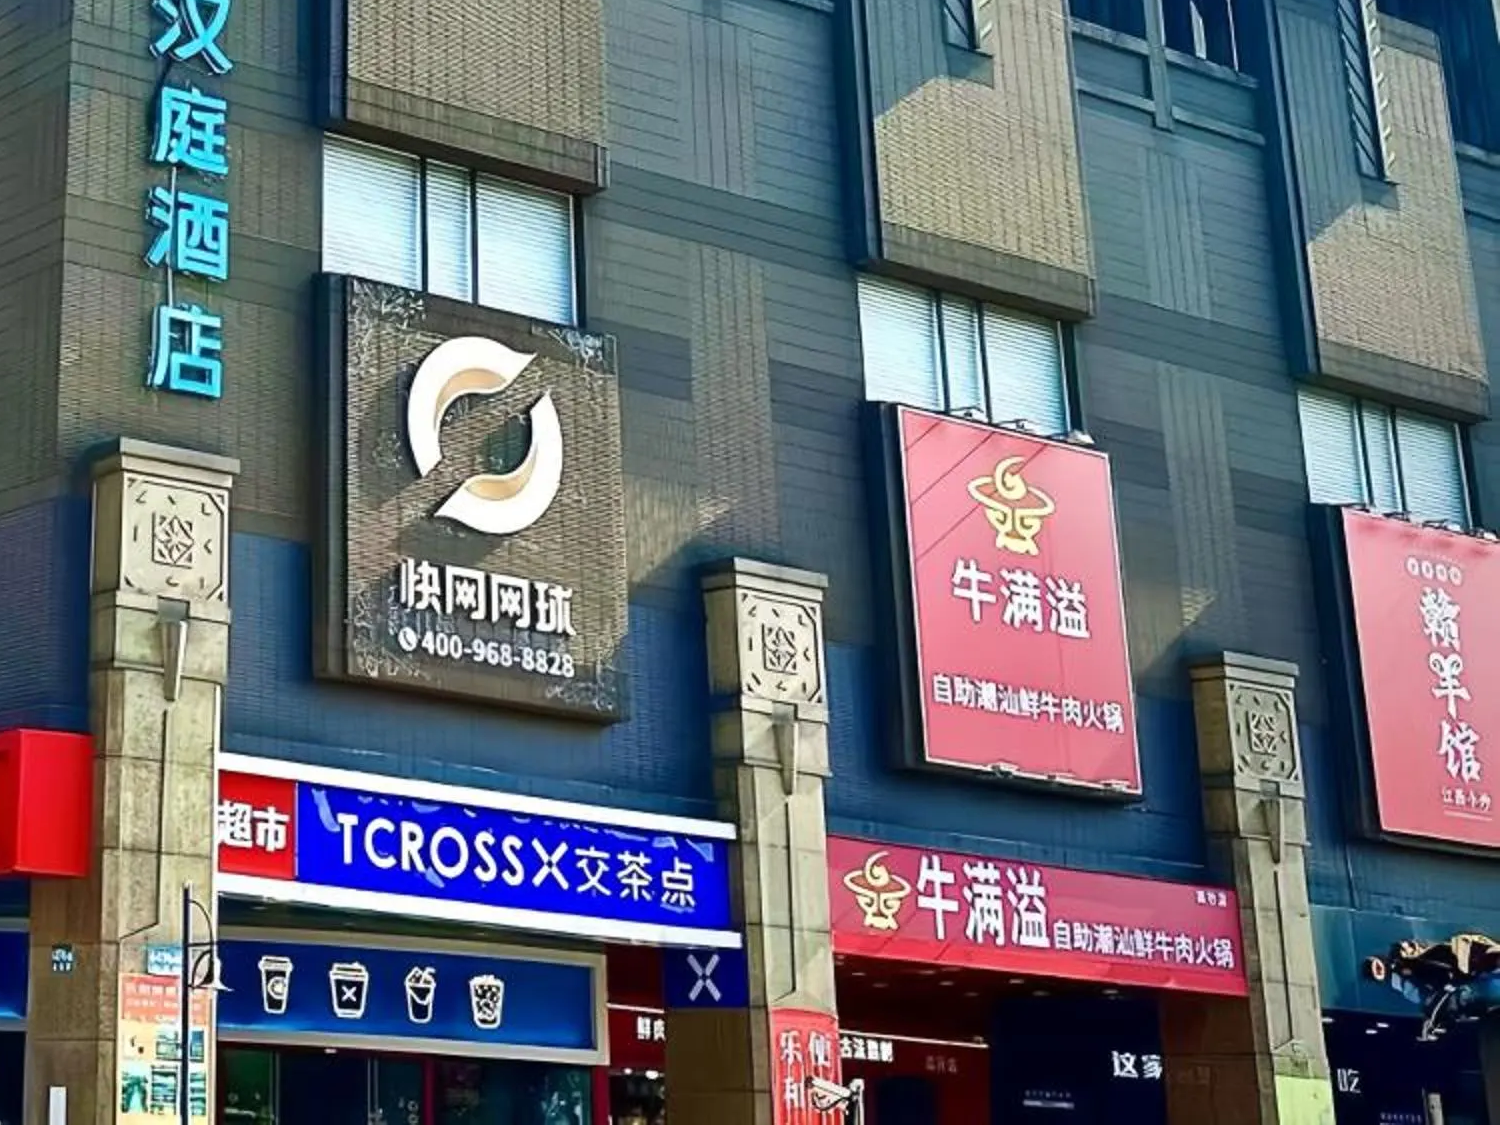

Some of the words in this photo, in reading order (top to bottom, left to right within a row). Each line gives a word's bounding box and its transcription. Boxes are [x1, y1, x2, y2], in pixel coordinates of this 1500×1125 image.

[952, 558, 1091, 640] 牛满溢
[421, 632, 575, 678] 400-968-8828
[933, 673, 1125, 734] 自助潮汕鲜牛肉火锅
[218, 798, 290, 852] 超市
[915, 852, 1050, 949] 牛满溢
[1053, 919, 1236, 969] 自助潮汕鲜牛肉火锅
